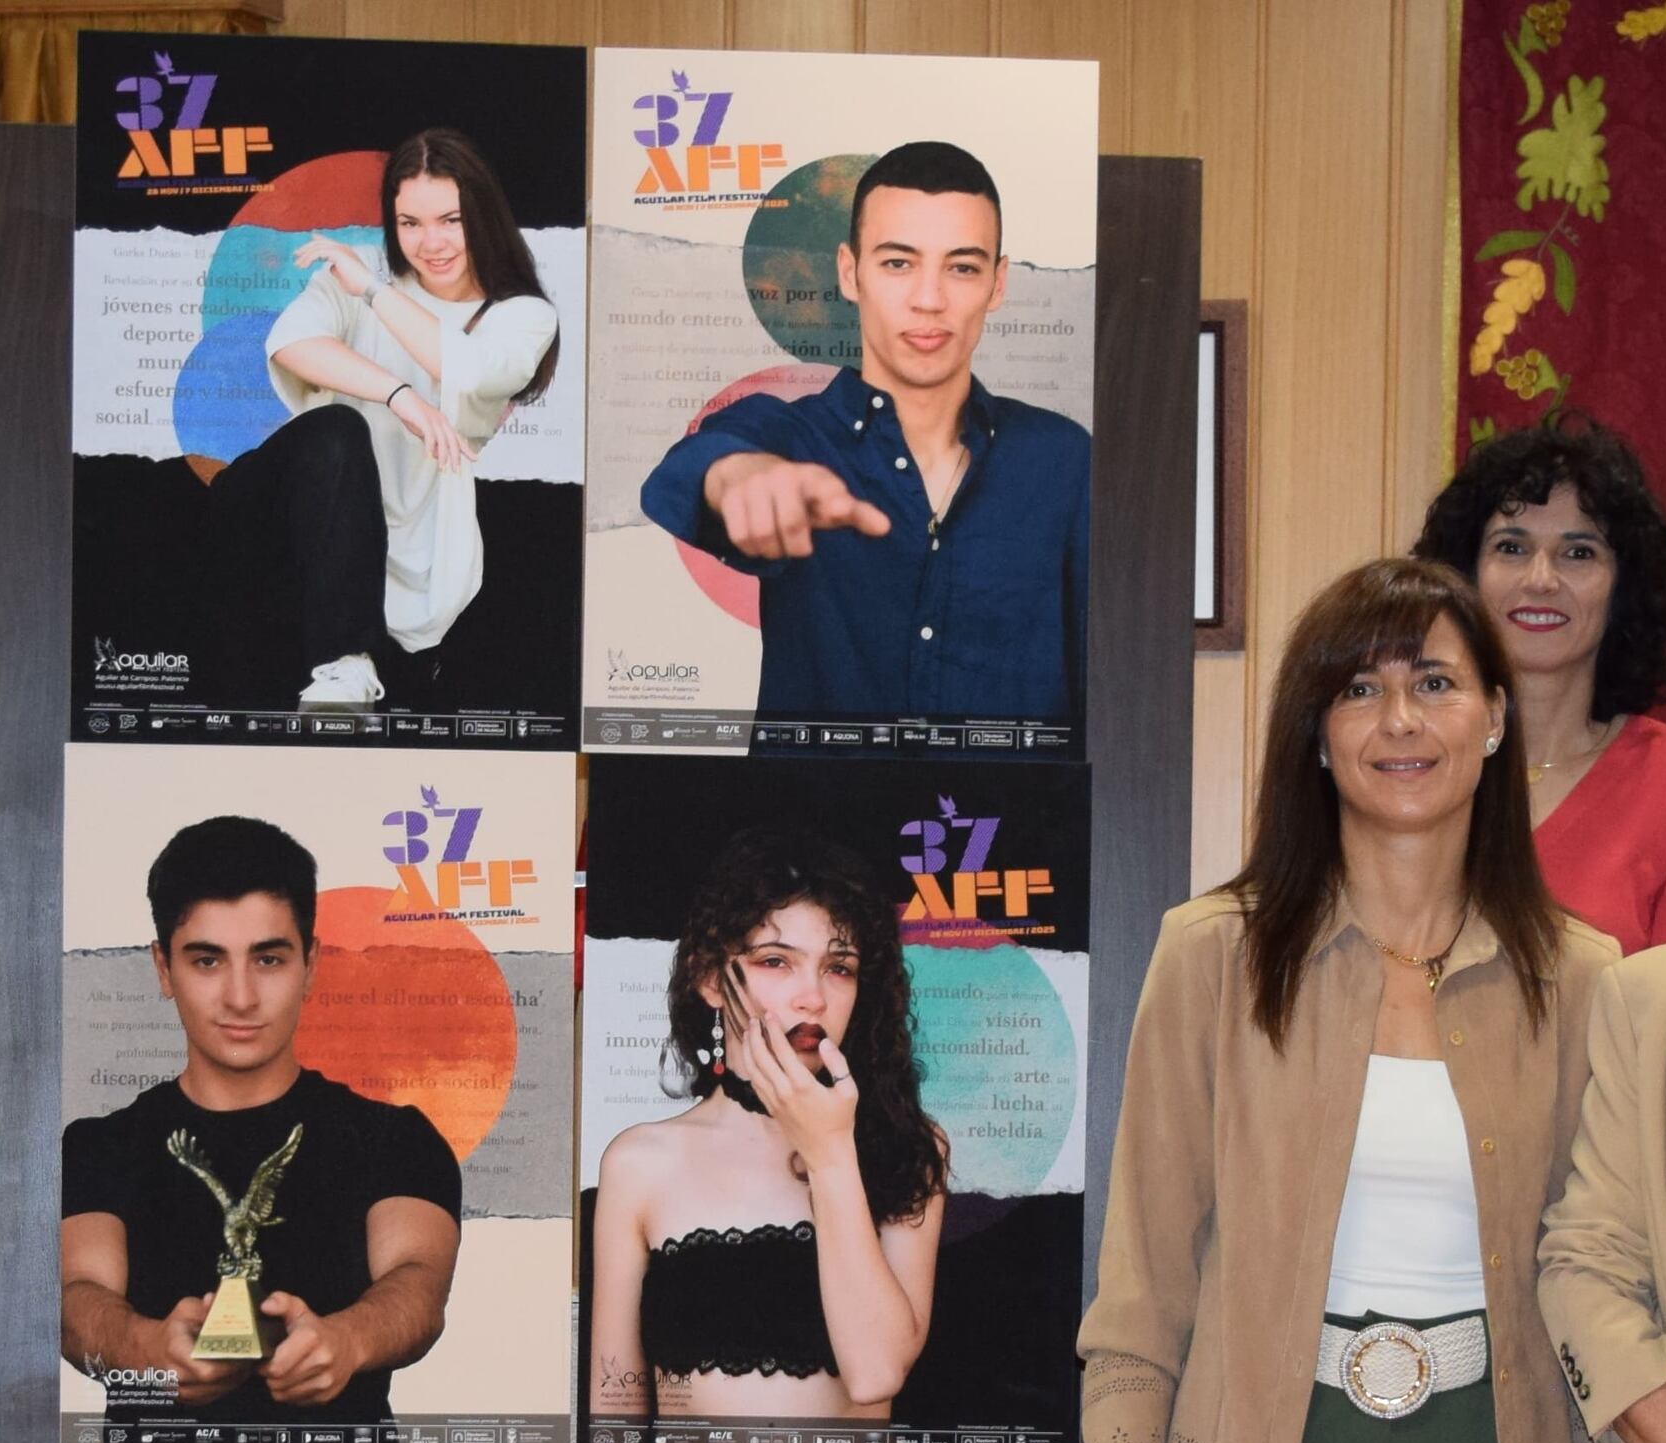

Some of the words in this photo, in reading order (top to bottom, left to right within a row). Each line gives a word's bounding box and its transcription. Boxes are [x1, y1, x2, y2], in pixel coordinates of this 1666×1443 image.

[115, 75, 218, 131] 37
[634, 92, 733, 149] 37
[116, 126, 273, 179] AFF
[635, 144, 788, 194] AFF
[634, 195, 685, 205] AGUILAR
[687, 194, 715, 203] FILM
[197, 270, 290, 292] disciplina
[102, 295, 173, 316] jóvenes
[179, 299, 269, 317] creadores
[785, 288, 818, 305] por
[608, 310, 676, 326] mundo
[681, 313, 743, 328] entero
[123, 324, 194, 345] deporte
[138, 348, 207, 370] mundo
[762, 339, 821, 358] acción
[654, 365, 722, 382] ciencia
[115, 380, 193, 400] esfuerzo
[501, 418, 539, 435] idas
[382, 807, 483, 865] 37
[900, 817, 1002, 875] 37
[385, 860, 539, 910] AFF
[901, 869, 1054, 922] AFF
[383, 912, 436, 923] AGUILAR
[438, 910, 467, 921] FILM
[469, 908, 526, 919] FESTIVAL
[319, 991, 354, 1008] que
[360, 987, 376, 1005] el
[383, 988, 459, 1006] silencio
[986, 1011, 1042, 1029] visión
[91, 1067, 178, 1090] discapaci
[361, 1073, 438, 1092] impacto
[442, 1072, 502, 1090] social.
[195, 1428, 221, 1438] AC/E
